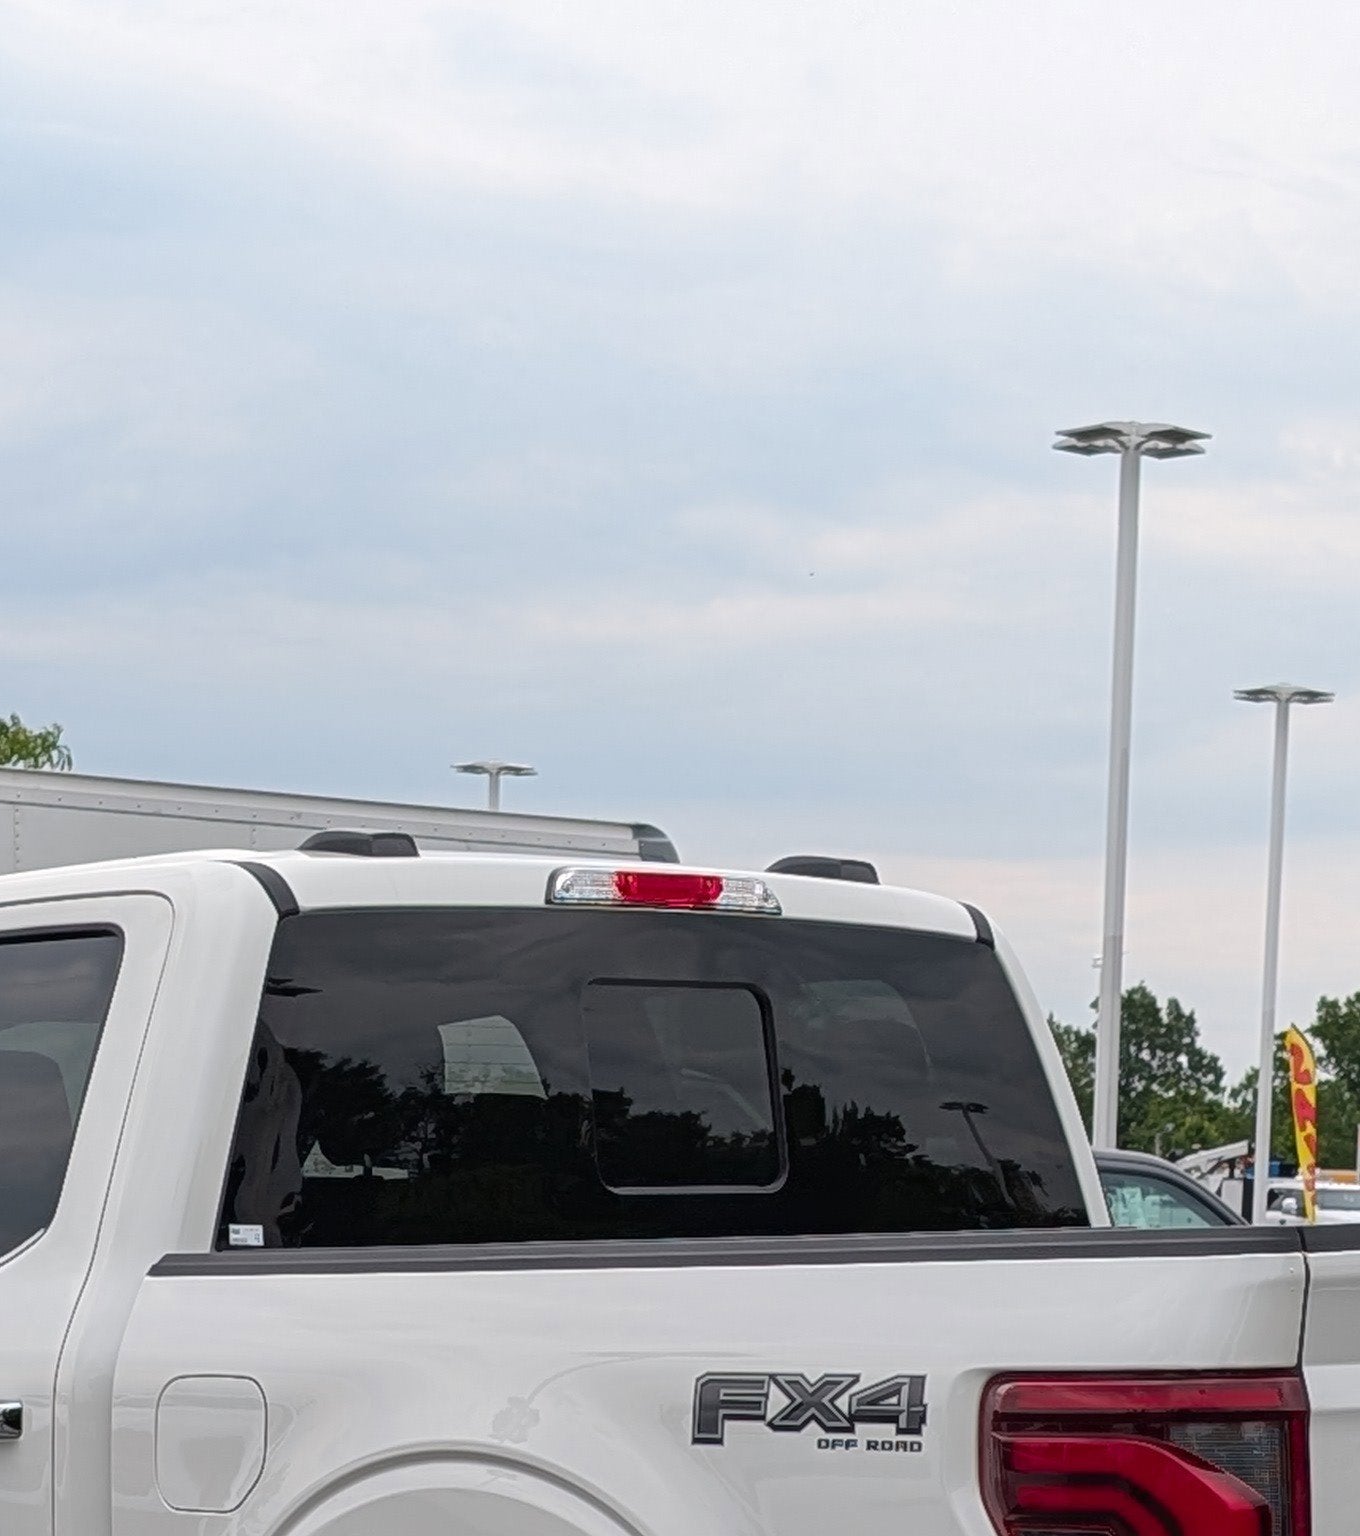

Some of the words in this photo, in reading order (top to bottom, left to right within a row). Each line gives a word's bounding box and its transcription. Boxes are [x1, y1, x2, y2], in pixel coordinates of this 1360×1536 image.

[691, 1371, 928, 1445] FX4
[817, 1438, 859, 1450] OFF
[866, 1439, 923, 1452] ROAD
